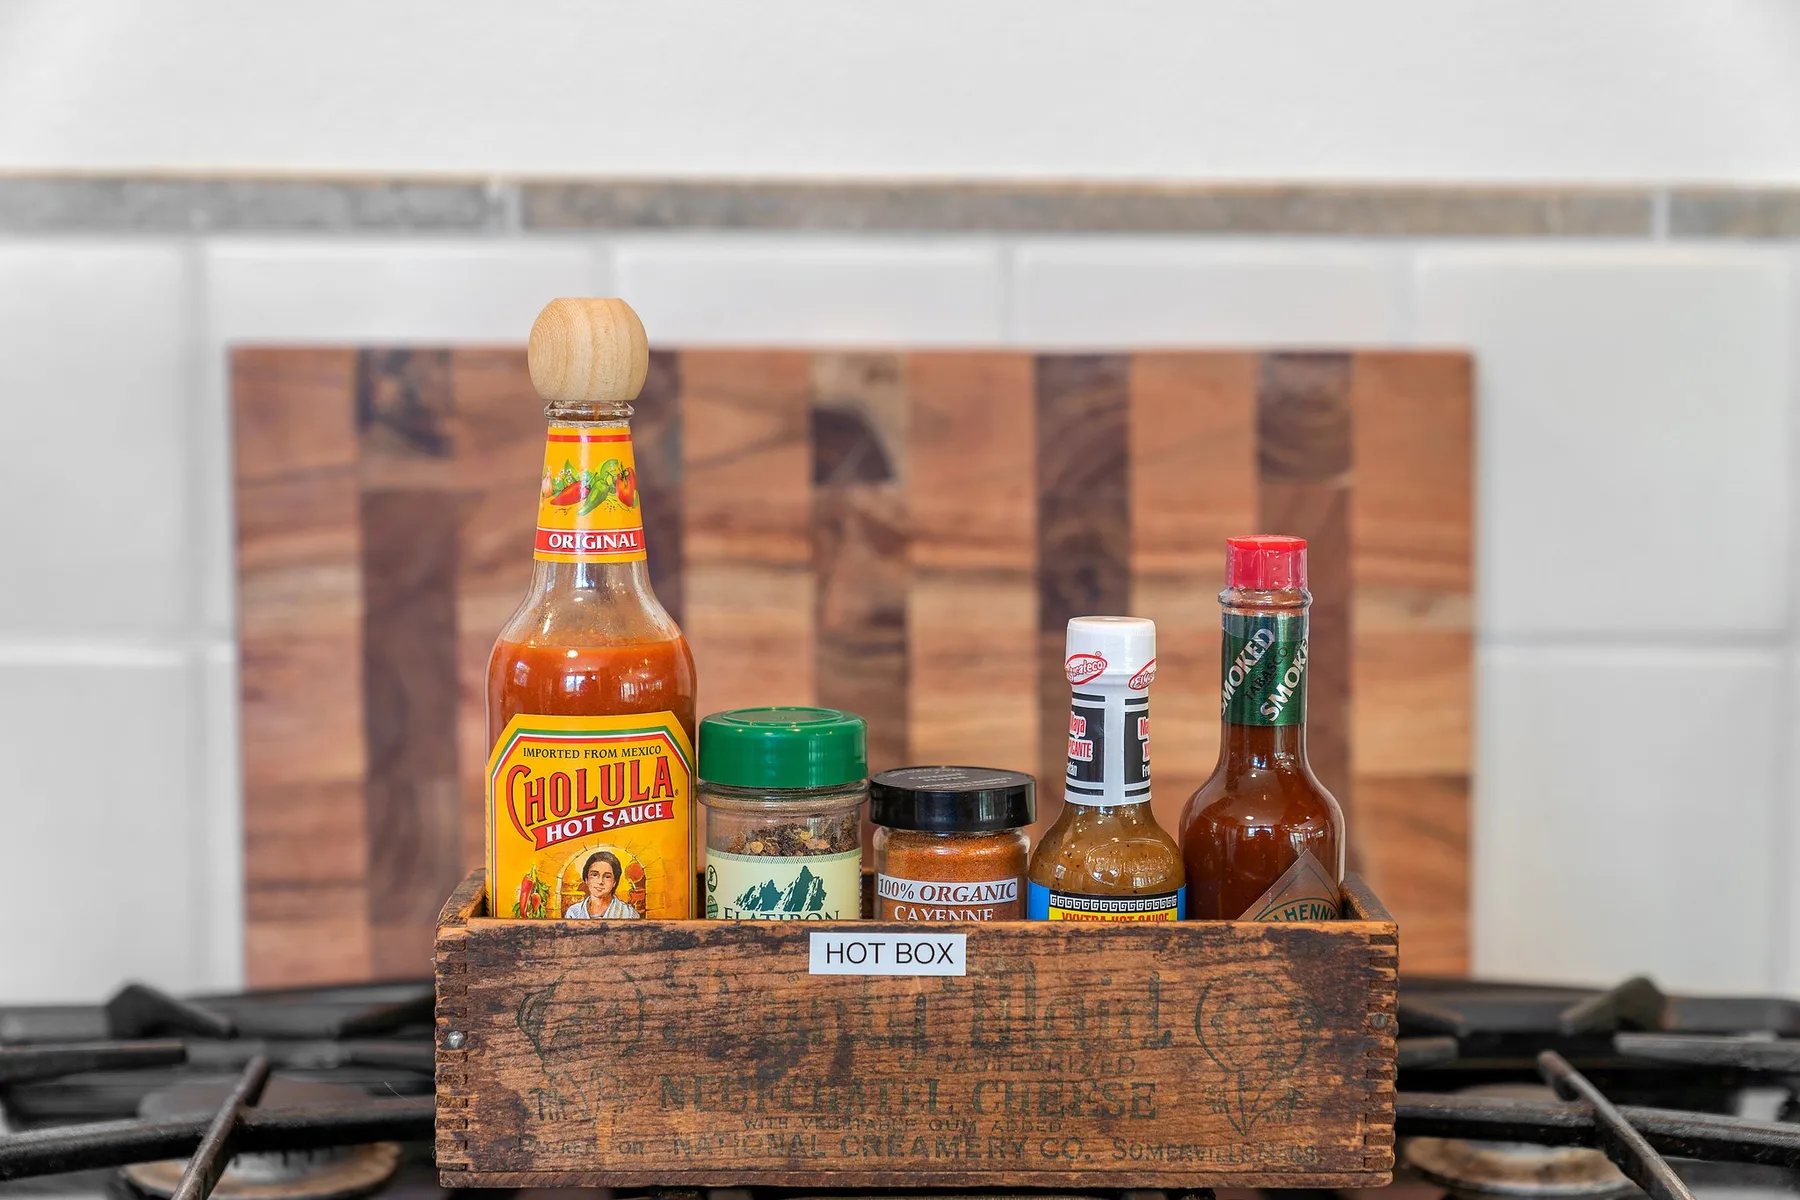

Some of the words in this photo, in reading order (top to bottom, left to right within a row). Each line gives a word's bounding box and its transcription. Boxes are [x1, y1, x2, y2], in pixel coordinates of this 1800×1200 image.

[548, 533, 638, 550] ORIGINAL
[523, 747, 580, 759] IMPORTED
[584, 748, 618, 759] FROM
[621, 745, 662, 757] MEXICO
[505, 755, 676, 843] CHOLULA
[546, 815, 597, 843] HOT
[602, 801, 664, 828] SAUCE
[879, 877, 915, 900] 100%
[919, 881, 1017, 902] ORGANIC
[826, 942, 886, 964] HOT
[896, 942, 954, 964] BOX
[971, 1078, 1157, 1121] CHEESE
[991, 1119, 1063, 1133] ADDED
[673, 1132, 826, 1160] NATIONAL
[840, 1134, 1029, 1160] CREAMERY
[1040, 1137, 1092, 1161] CO.
